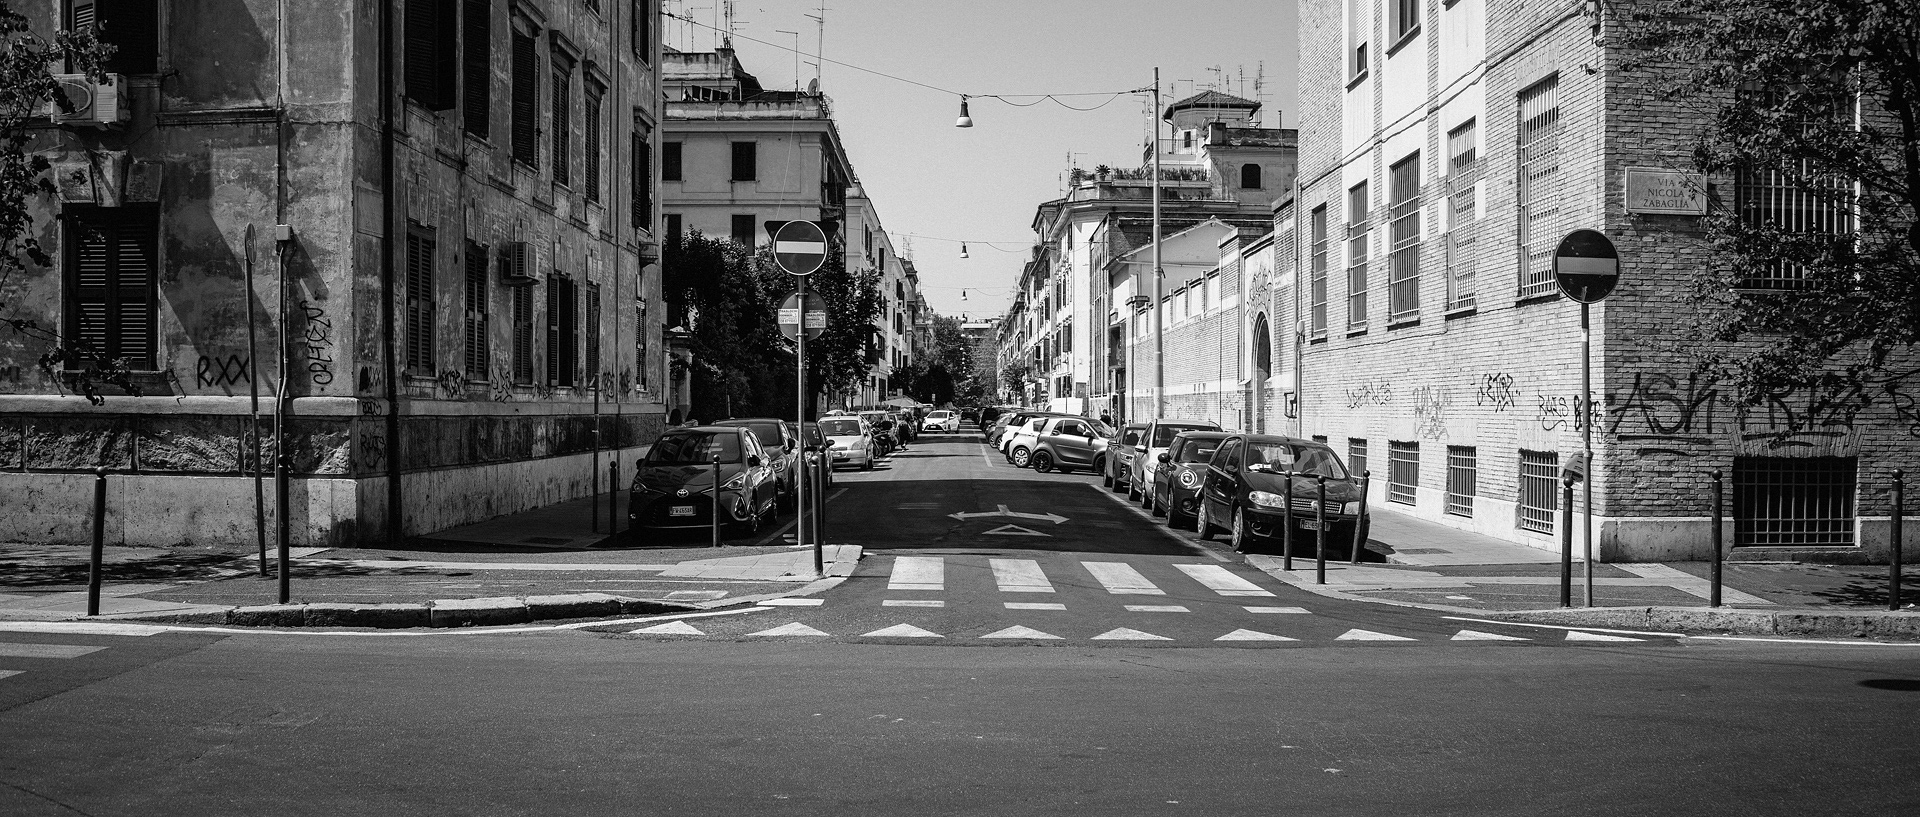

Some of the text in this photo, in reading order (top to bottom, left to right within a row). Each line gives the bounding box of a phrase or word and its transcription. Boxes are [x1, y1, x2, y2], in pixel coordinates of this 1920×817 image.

[1657, 178, 1675, 187] VIA
[1647, 188, 1685, 197] NICOLA
[1643, 199, 1690, 208] ZABAGLIA
